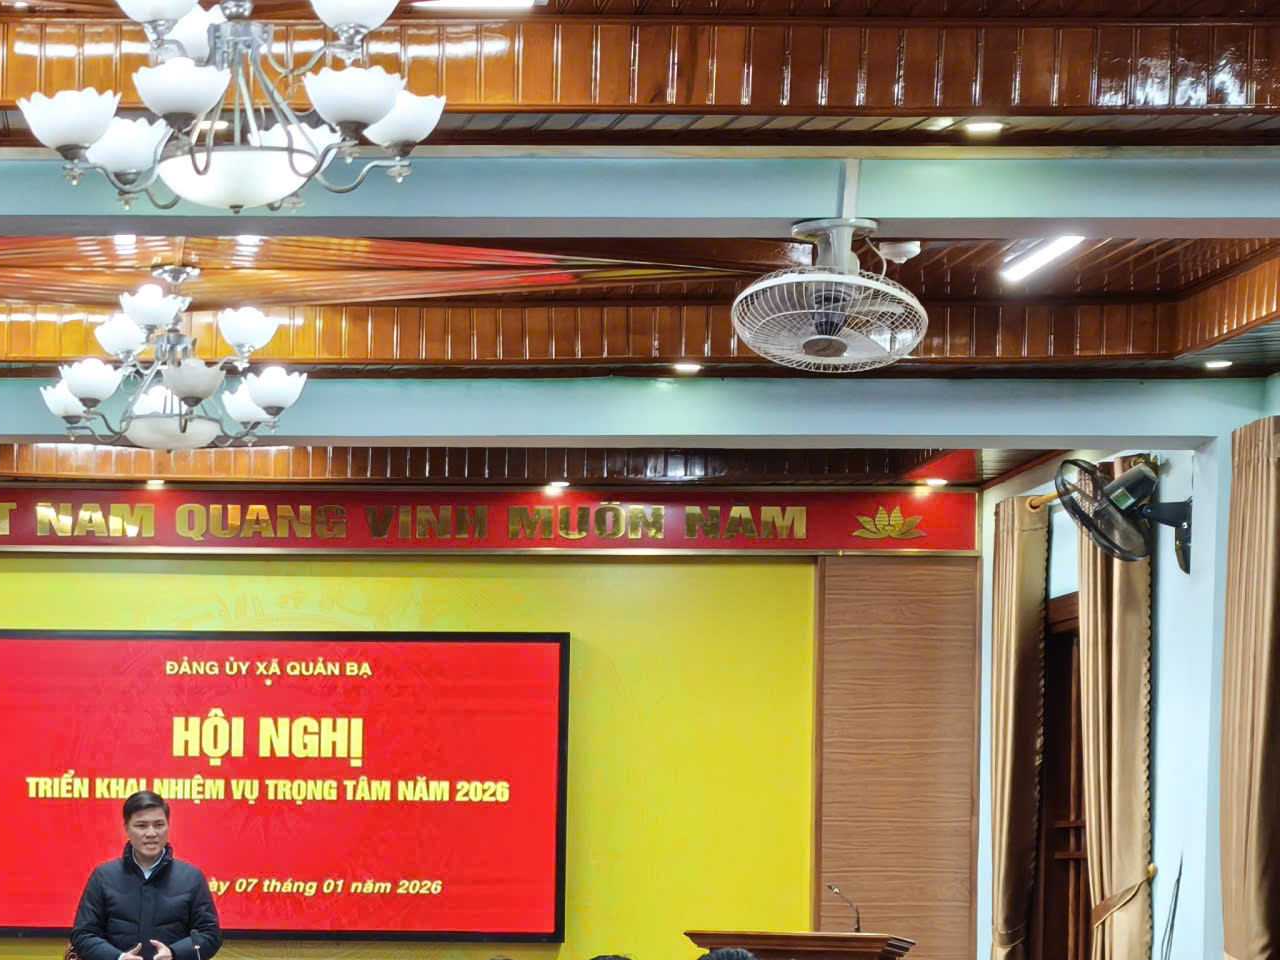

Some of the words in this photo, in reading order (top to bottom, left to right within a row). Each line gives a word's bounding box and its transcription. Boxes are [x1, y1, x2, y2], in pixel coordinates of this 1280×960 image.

[35, 502, 156, 538] NAM
[174, 503, 348, 541] QUANG
[364, 505, 488, 539] VINH
[165, 656, 219, 675] ĐẢNG
[224, 656, 250, 675] ỦY
[255, 658, 281, 675] XÃ
[286, 657, 340, 676] QUẢN
[345, 661, 373, 679] BẠ
[172, 707, 245, 767] HỘI
[258, 716, 364, 767] NGHỊ
[26, 769, 89, 798] TRIỂN
[95, 778, 147, 798] KHAI
[152, 774, 225, 804] NHIỆM
[230, 779, 260, 804] VỤ
[265, 779, 338, 805] TRỌNG
[343, 776, 391, 801] TÂM
[397, 776, 450, 802] NĂM
[455, 780, 511, 802] 2026
[234, 878, 258, 893] 07
[262, 879, 317, 897] tháng
[322, 879, 344, 894] 01
[350, 879, 392, 894] năm
[396, 879, 443, 895] 2026
